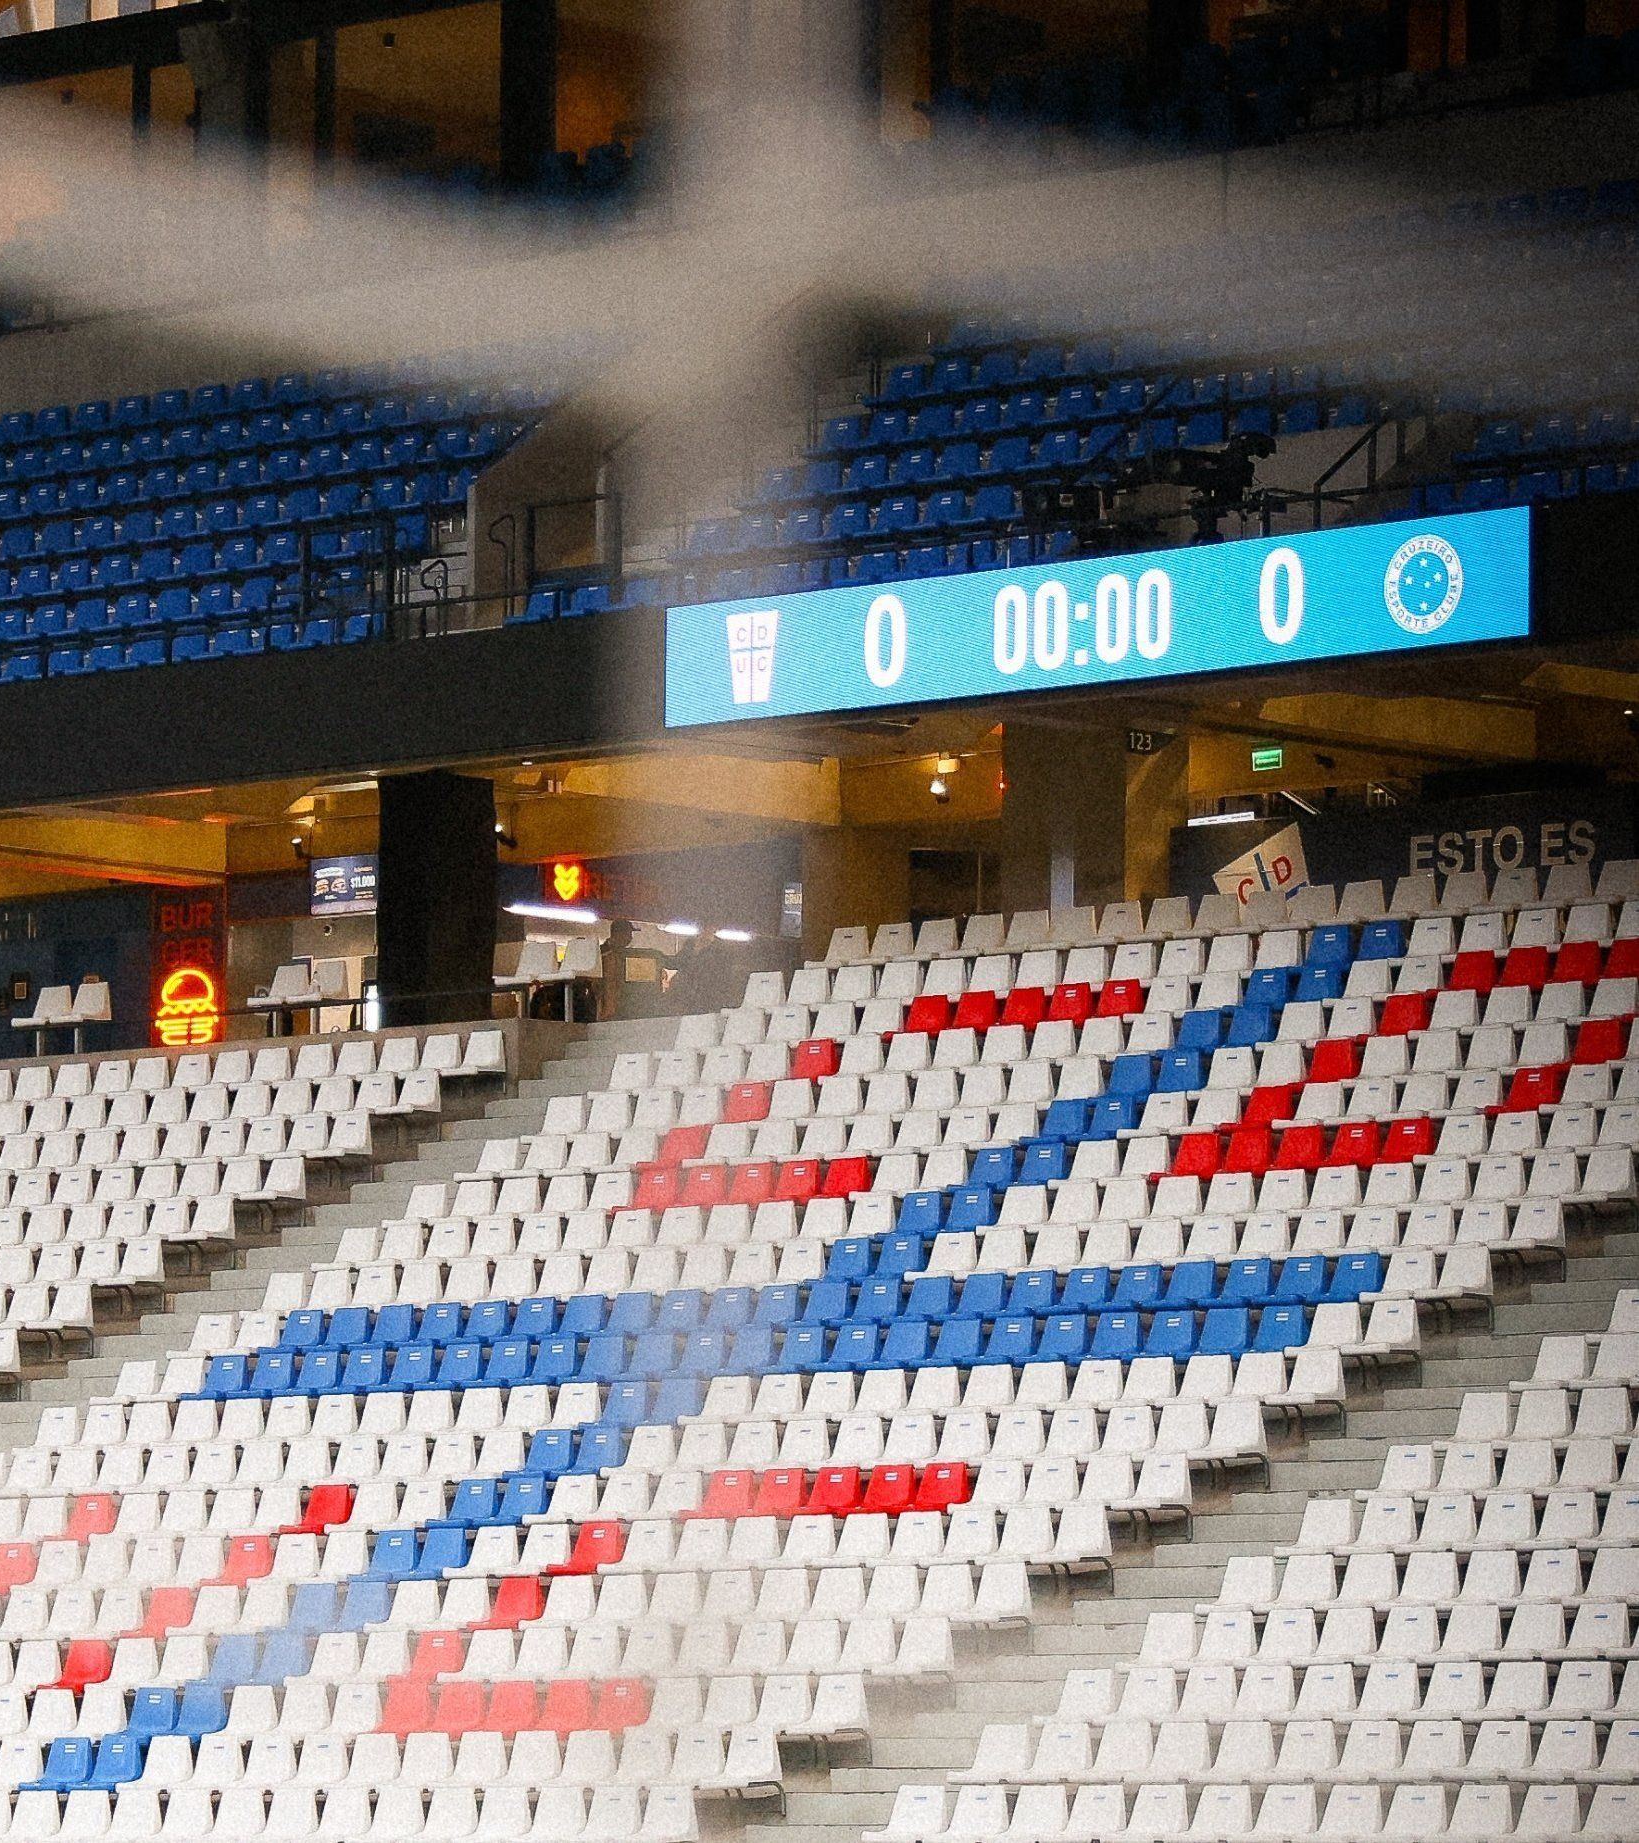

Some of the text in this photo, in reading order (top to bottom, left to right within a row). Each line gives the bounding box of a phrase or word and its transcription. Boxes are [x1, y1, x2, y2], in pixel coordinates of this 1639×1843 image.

[1394, 540, 1453, 570] CRUZEIRO
[863, 547, 1304, 688] 0 00:00 0
[1129, 732, 1152, 751] 123
[1409, 819, 1597, 876] ESTO ES
[161, 901, 214, 932] BUR
